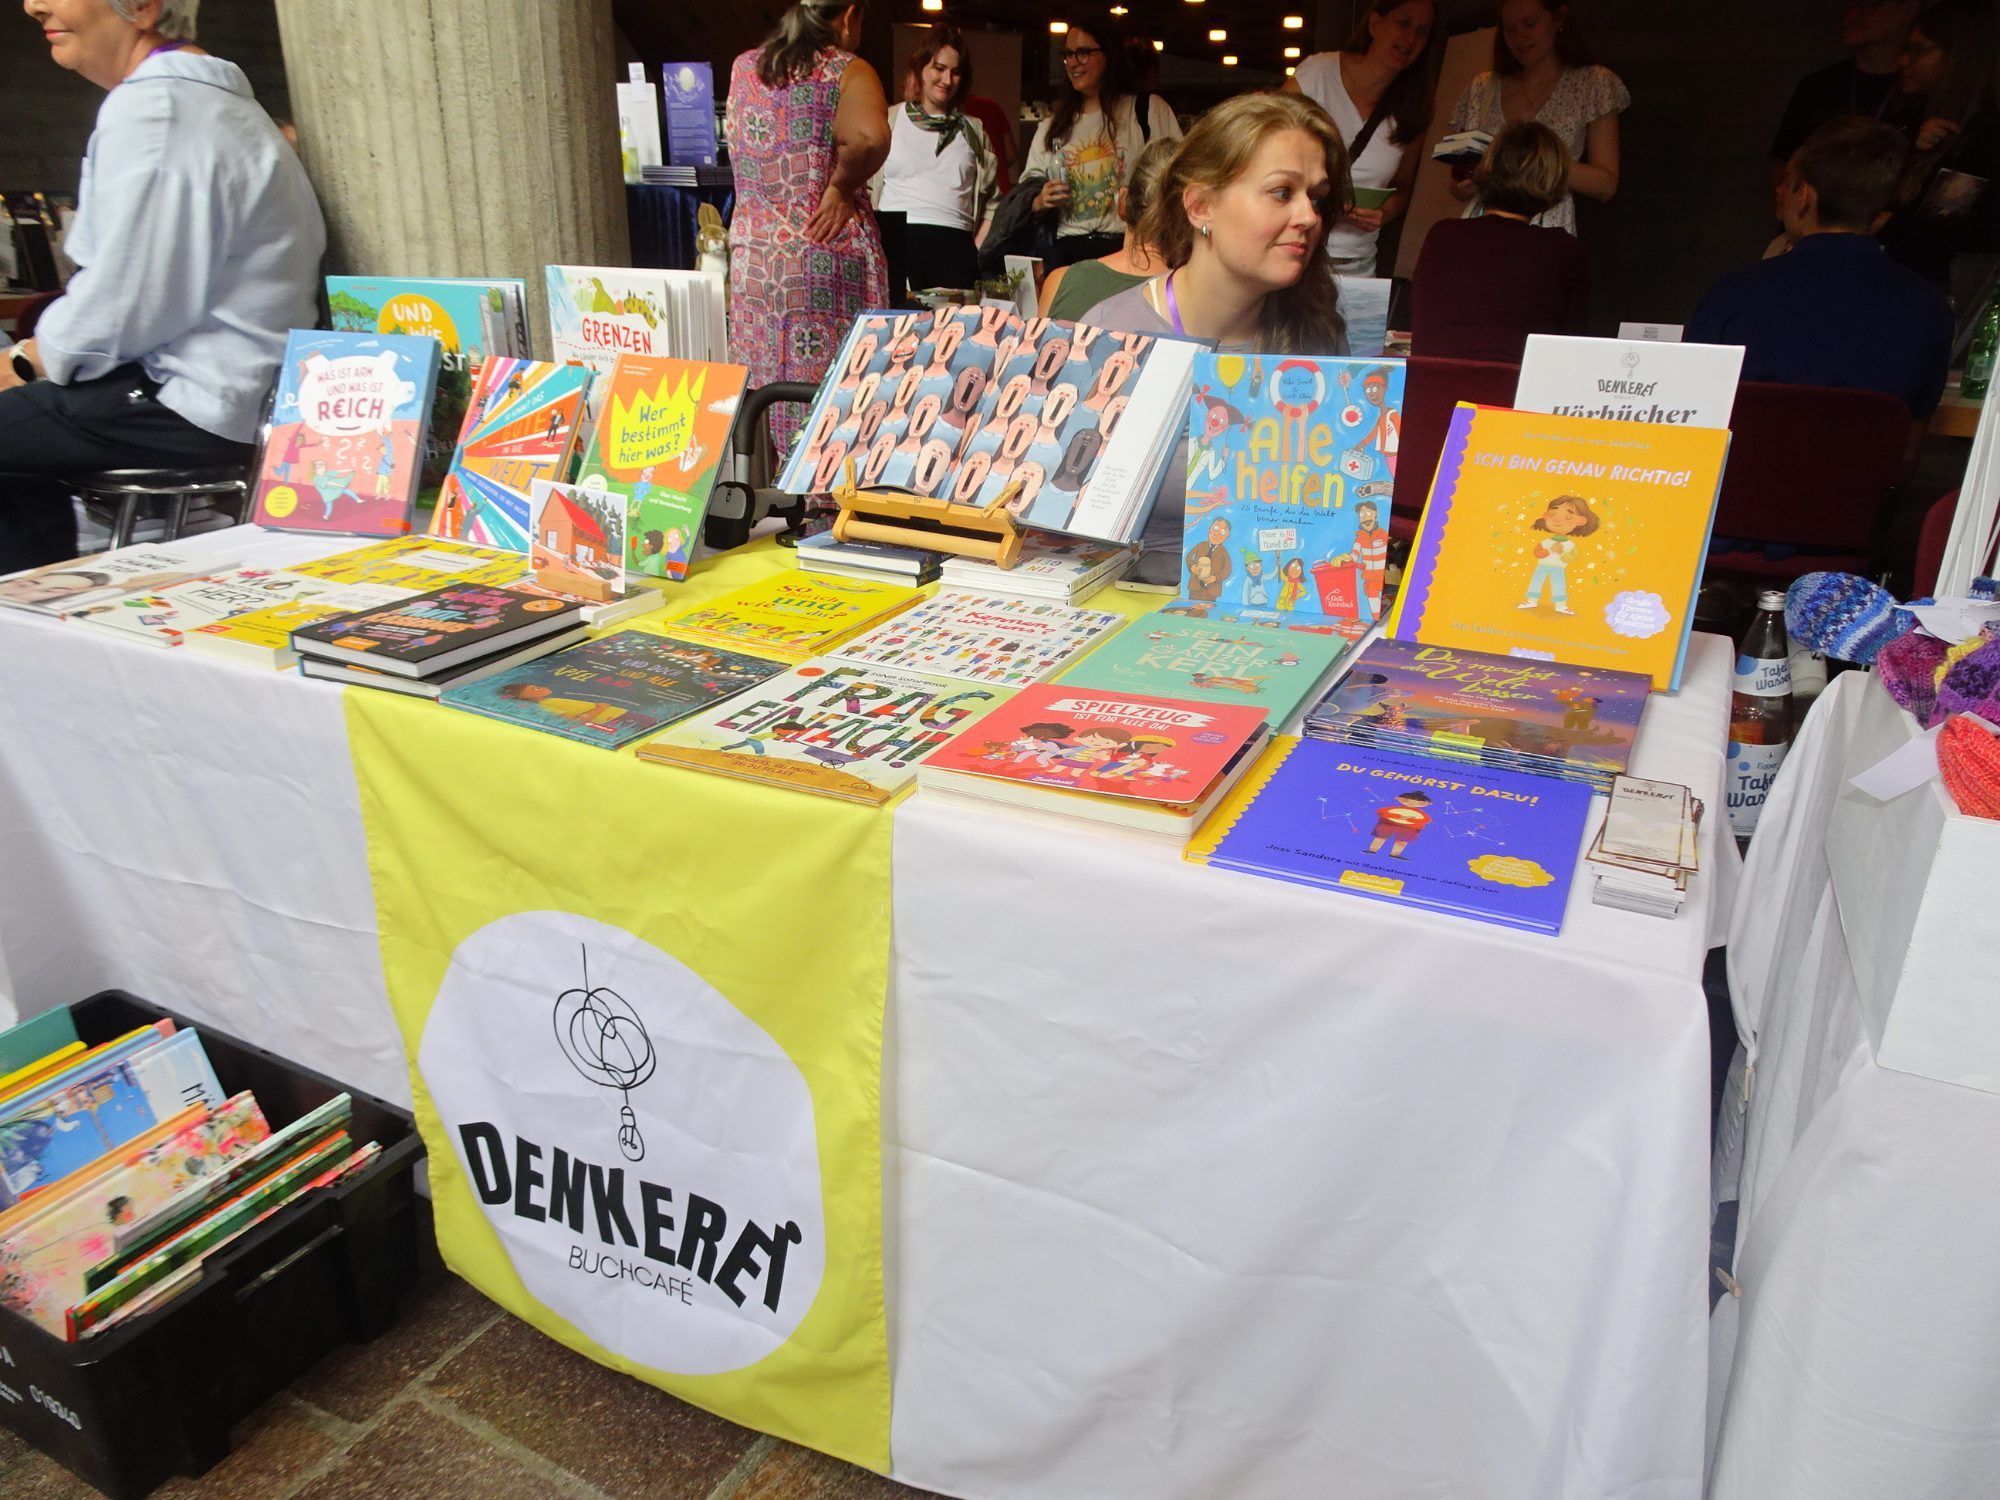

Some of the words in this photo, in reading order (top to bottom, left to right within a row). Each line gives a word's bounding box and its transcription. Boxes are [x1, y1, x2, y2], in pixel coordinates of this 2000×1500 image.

[392, 303, 432, 322] UND
[582, 318, 652, 354] GRENZEN
[317, 370, 335, 382] WAS
[338, 368, 351, 378] IST
[353, 367, 374, 377] ARM
[327, 384, 346, 396] UND
[349, 383, 368, 394] WAS
[370, 382, 384, 393] IST
[640, 405, 667, 423] Wer
[621, 413, 686, 443] bestimmt
[1249, 417, 1334, 467] Alle
[619, 448, 643, 463] hier
[1236, 450, 1345, 508] helfen
[1474, 452, 1504, 466] ICH
[1508, 454, 1541, 471] BIN
[1545, 459, 1606, 478] GENAU
[1610, 465, 1691, 487] RICHTIG!
[187, 587, 265, 606] HER?
[773, 597, 846, 611] und
[956, 618, 995, 627] wir
[995, 624, 1057, 636] uns?
[965, 611, 1049, 629] Kennen
[1174, 628, 1222, 640] SEI
[1150, 644, 1271, 668] GANZER
[1192, 639, 1265, 658] EIN
[1135, 652, 1255, 681] KERL
[1414, 648, 1462, 664] Du
[1468, 663, 1561, 680] machst
[1400, 664, 1431, 673] die
[1419, 662, 1531, 690] Welt
[782, 666, 996, 730] FRAG
[1459, 682, 1543, 700] besser
[1071, 700, 1192, 724] SPIELZEUG
[1074, 713, 1092, 721] IST
[1094, 713, 1117, 724] FÜR
[1119, 717, 1146, 728] ALLE
[1149, 721, 1171, 731] DA!
[714, 700, 955, 768] EINFACH!
[1336, 763, 1366, 774] DU
[1370, 769, 1466, 791] GEHÖRST
[1470, 786, 1540, 807] DAZU!
[1738, 773, 1776, 791] Tafe
[1727, 792, 1765, 808] Was
[1294, 848, 1342, 863] Sanders
[1474, 885, 1500, 894] Chen
[568, 1244, 693, 1306] BUCHCAFÉ
